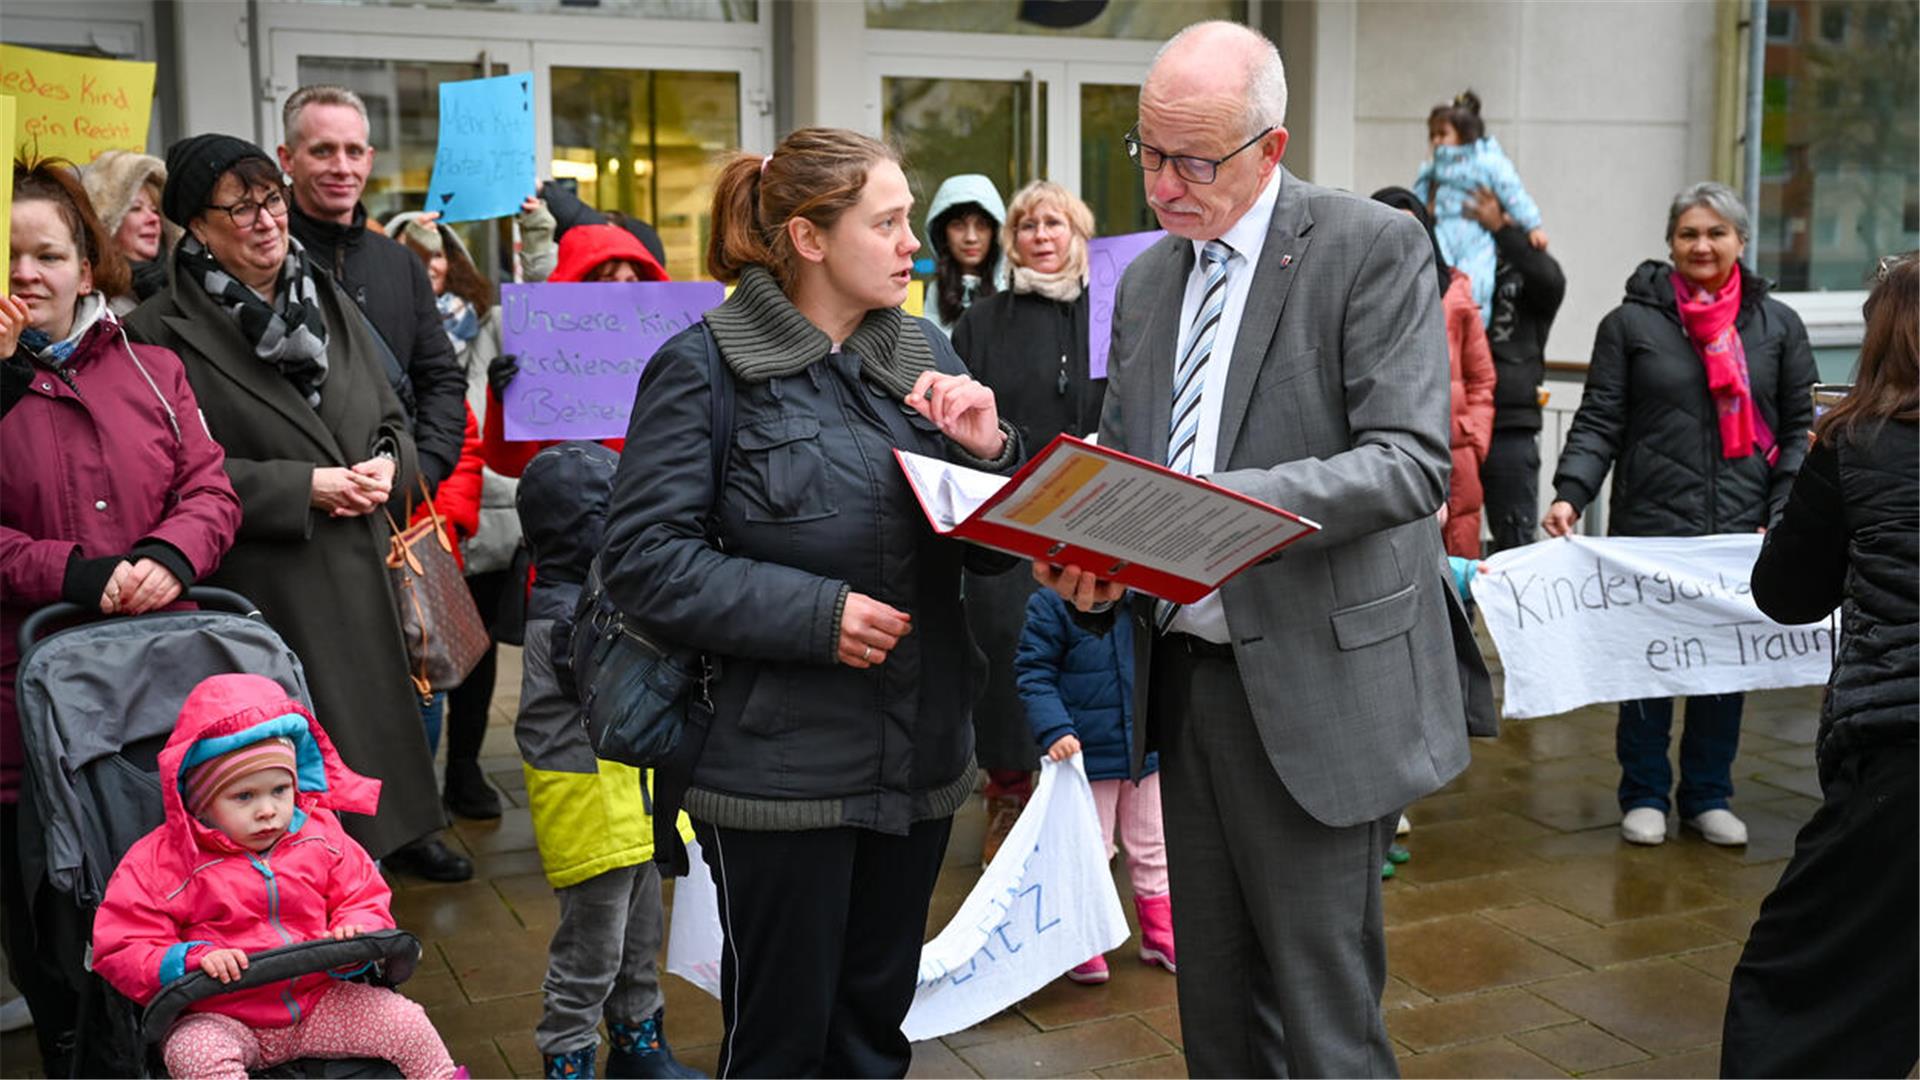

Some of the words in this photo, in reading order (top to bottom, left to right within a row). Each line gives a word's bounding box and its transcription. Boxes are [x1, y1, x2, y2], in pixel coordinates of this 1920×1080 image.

[0, 68, 70, 101] edes
[80, 73, 130, 110] Kind
[24, 115, 66, 136] ein
[73, 115, 130, 140] Recht
[507, 295, 624, 334] Unsere
[1502, 557, 1751, 629] Kindergarte
[1646, 636, 1707, 672] ein
